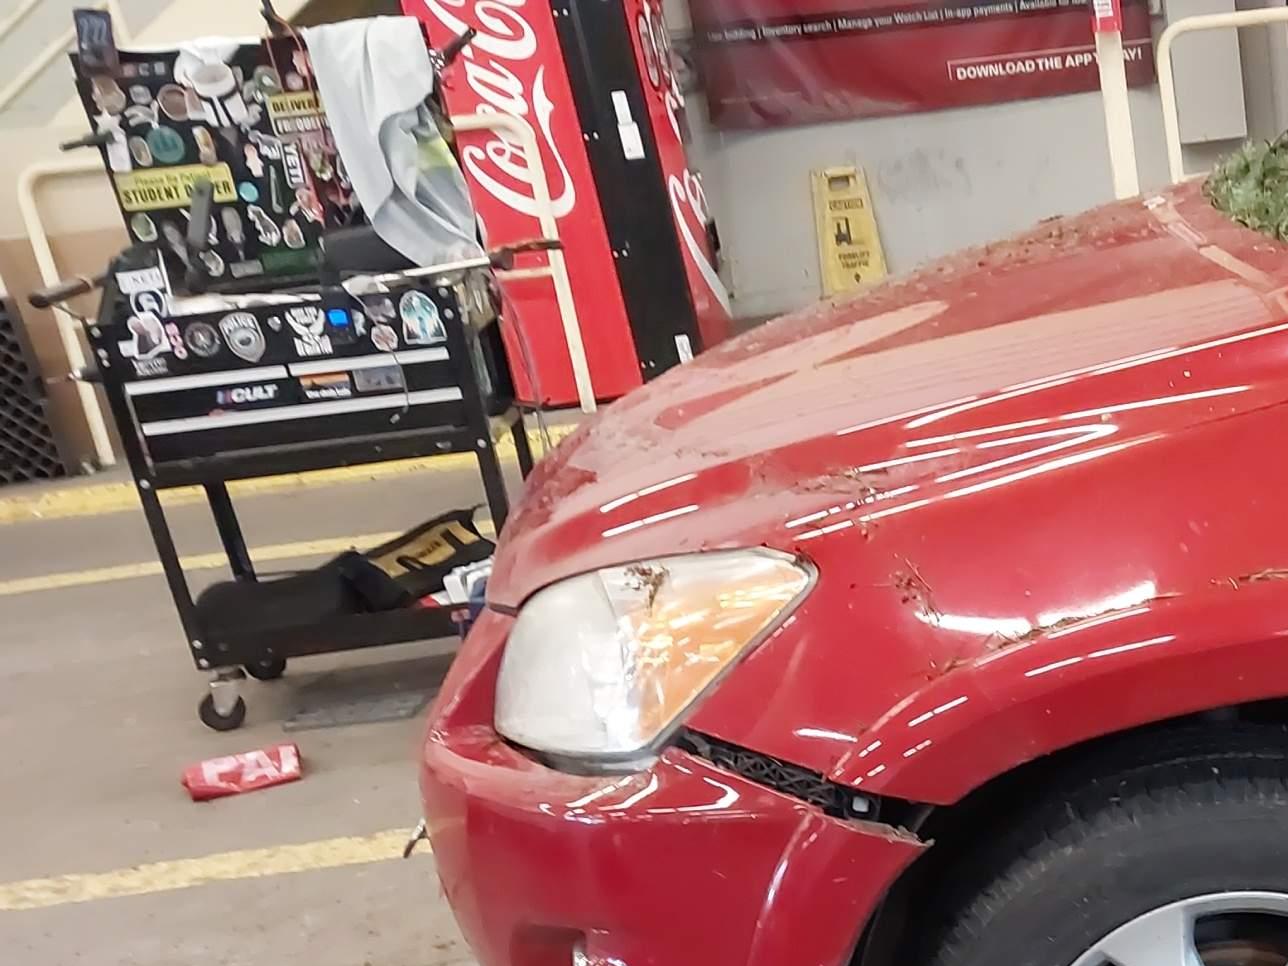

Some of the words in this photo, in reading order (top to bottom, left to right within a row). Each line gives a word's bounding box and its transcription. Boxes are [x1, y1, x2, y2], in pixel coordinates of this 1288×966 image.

[803, 21, 832, 33] search
[837, 18, 872, 31] Manage
[973, 2, 1013, 18] payments
[957, 61, 1036, 80] DOWNLOAD
[1037, 55, 1064, 72] THE
[1065, 52, 1093, 68] APP
[283, 143, 304, 184] YETI
[123, 183, 181, 203] STUDENT
